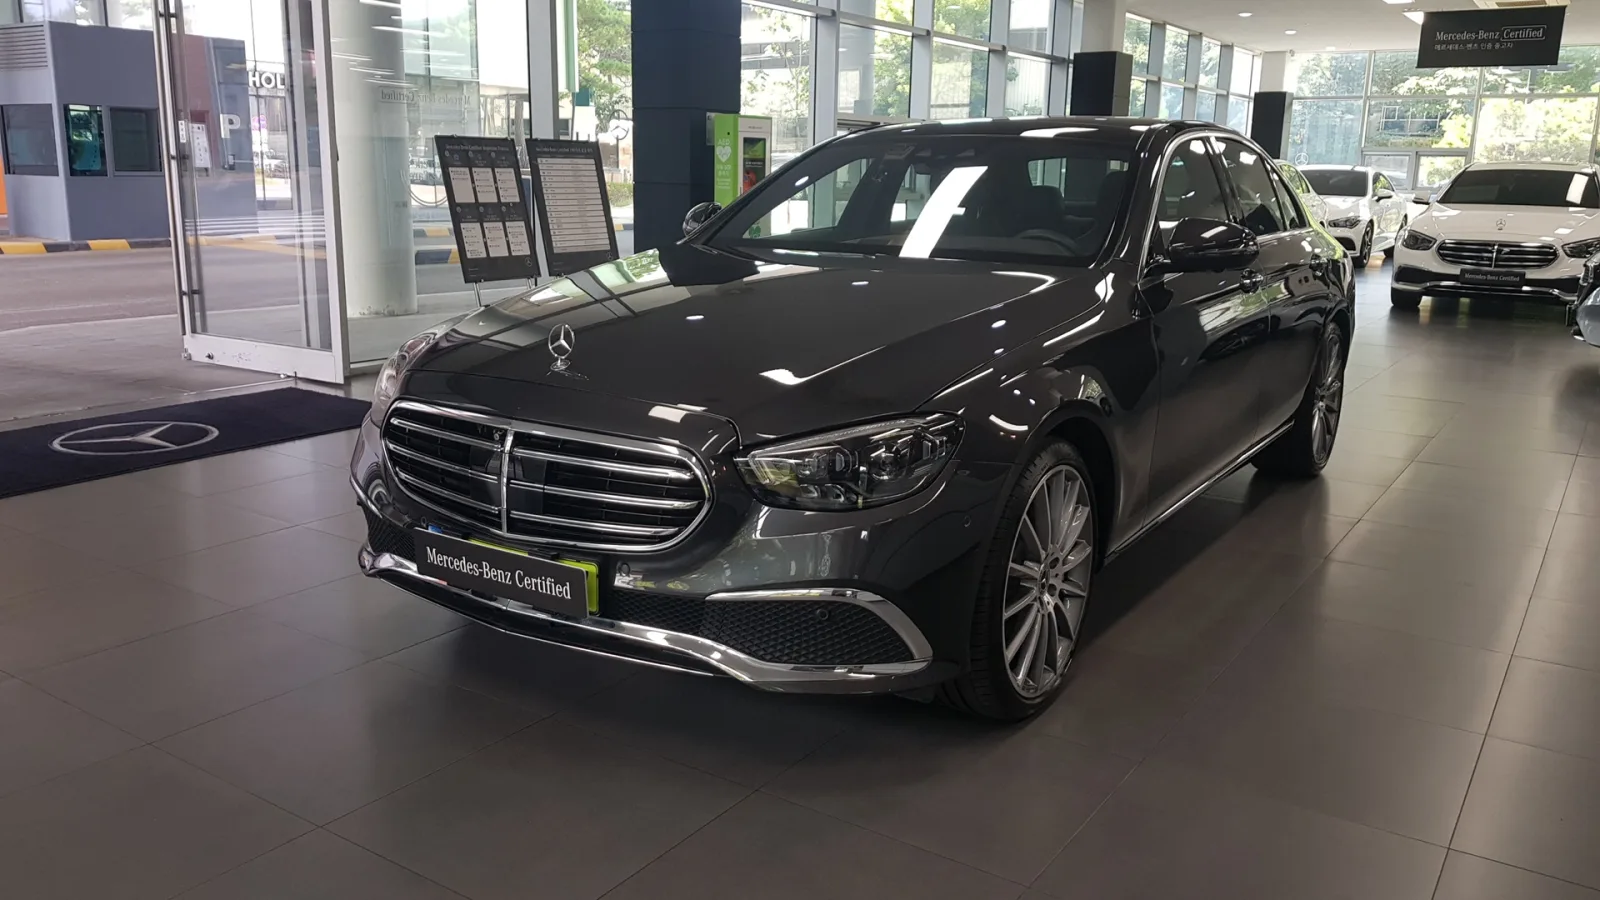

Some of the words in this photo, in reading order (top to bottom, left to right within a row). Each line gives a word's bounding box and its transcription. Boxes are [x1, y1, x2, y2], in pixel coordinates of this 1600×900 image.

[1435, 30, 1500, 41] Mercedes-Benz
[1503, 28, 1544, 39] Certified
[220, 113, 241, 139] P
[1464, 273, 1498, 281] Mercedes-Benz
[426, 546, 512, 585] Mercedes-Benz
[515, 569, 571, 600] Certified
